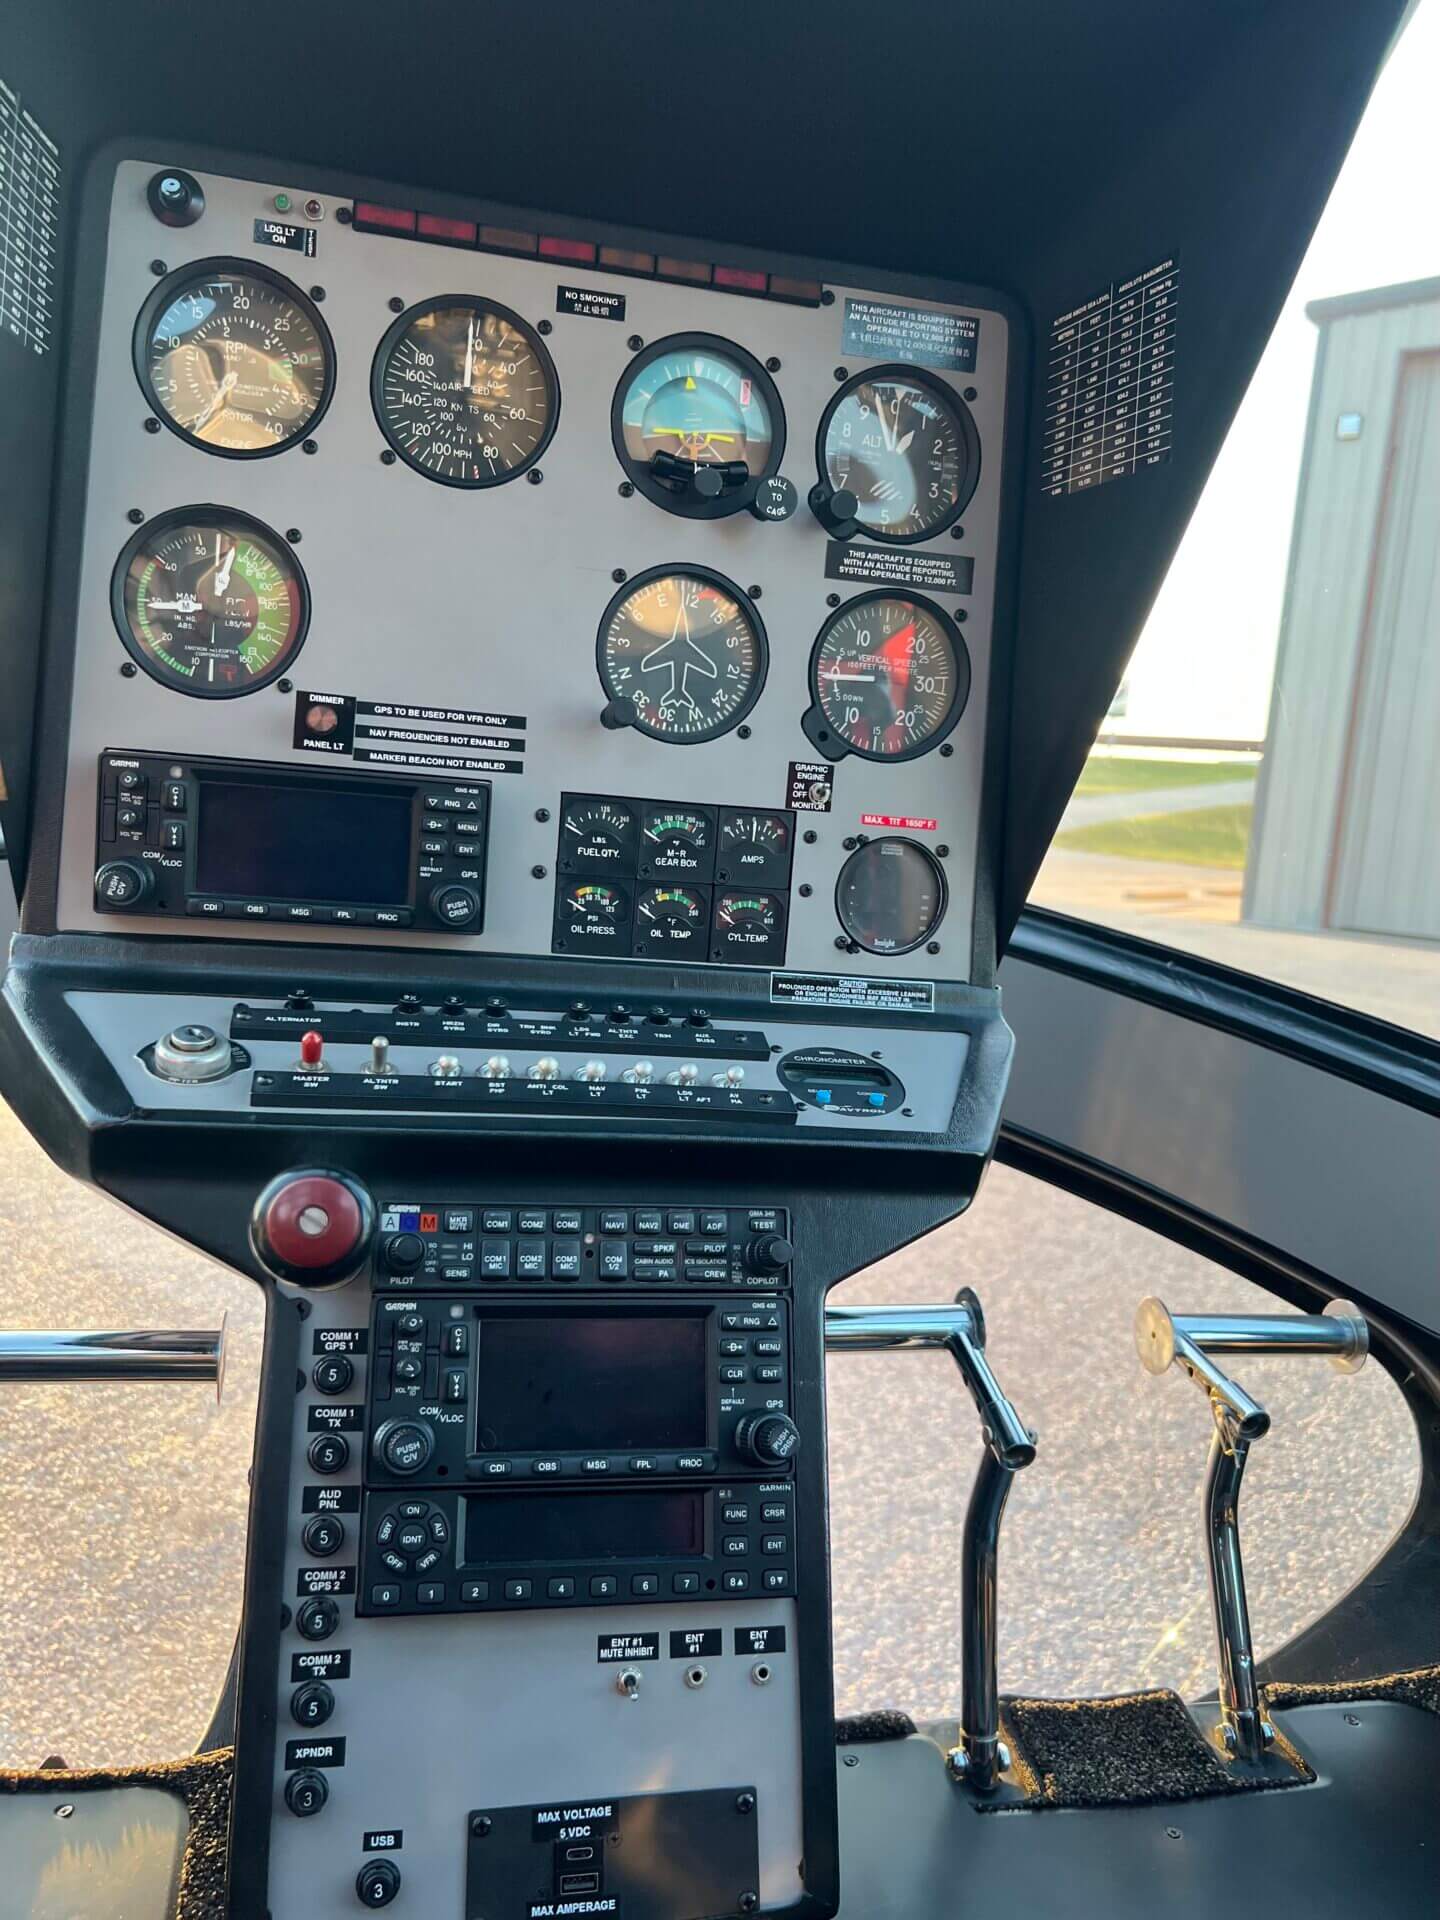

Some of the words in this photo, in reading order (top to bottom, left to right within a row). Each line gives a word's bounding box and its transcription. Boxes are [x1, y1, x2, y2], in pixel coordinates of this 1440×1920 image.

[264, 224, 284, 233] LDG
[285, 227, 296, 237] LT
[272, 235, 286, 244] ON
[233, 297, 249, 309] 20
[565, 291, 578, 300] NO
[579, 293, 618, 306] SMOKING
[192, 307, 203, 319] 15
[851, 303, 868, 312] THIS
[869, 307, 906, 319] AIRCRAFT
[917, 314, 955, 326] EQUIPPED
[274, 318, 290, 330] 25
[168, 337, 180, 348] 10
[415, 354, 434, 366] 180
[406, 369, 424, 382] 160
[402, 394, 422, 406] 140
[510, 408, 525, 420] 60
[859, 405, 870, 420] 9
[412, 424, 431, 436] 120
[842, 424, 851, 436] 8
[862, 435, 883, 447] ALT
[432, 445, 451, 455] 100
[483, 446, 498, 458] 80
[933, 440, 943, 454] 2
[453, 450, 472, 459] MPH
[768, 479, 788, 490] PULL
[929, 483, 939, 498] 3
[772, 493, 782, 501] TO
[766, 506, 786, 516] CAGE
[849, 550, 865, 559] THIS
[866, 552, 904, 563] AIRCRAFT
[914, 558, 951, 569] EQUIPPED
[165, 563, 177, 571] 40
[843, 558, 863, 566] WITH
[864, 560, 874, 568] AN
[875, 561, 910, 572] ALTITUDE
[912, 566, 955, 577] REPORTING
[839, 566, 869, 576] SYSTEM
[870, 570, 910, 581] OPERABLE
[686, 593, 698, 608] 12
[710, 609, 725, 624] 15
[162, 633, 173, 641] 20
[726, 636, 738, 648] S
[857, 630, 870, 646] 10
[906, 638, 925, 654] 20
[858, 654, 890, 664] VERTICAL
[893, 658, 916, 668] SPEED
[618, 667, 632, 679] N
[914, 676, 934, 692] 30
[310, 694, 344, 704] DIMMER
[375, 706, 392, 715] GPS
[395, 707, 406, 716] TO
[409, 709, 420, 717] BE
[422, 710, 445, 720] USED
[447, 713, 464, 721] FOR
[466, 714, 484, 723] VFR
[485, 716, 507, 726] ONLY
[845, 706, 859, 723] 10
[895, 710, 915, 727] 20
[304, 739, 332, 749] PANEL
[370, 729, 386, 737] NAV
[389, 730, 449, 743] FREQUENCIES
[451, 735, 468, 745] NOT
[470, 737, 510, 749] ENABLED
[370, 753, 406, 762] MARKER
[409, 756, 445, 766] BEACON
[447, 759, 464, 767] NOT
[466, 760, 505, 770] ENABLED
[795, 764, 828, 773] GRAPHIC
[797, 773, 825, 781] ENGINE
[445, 800, 460, 808] RNG
[791, 802, 825, 810] MONITOR
[864, 815, 884, 824] MAX.
[889, 817, 901, 825] TIT
[577, 847, 600, 856] FUEL
[601, 849, 620, 858] QTY.
[741, 855, 764, 864] AMPS
[571, 925, 584, 933] OIL
[586, 926, 616, 935] PRESS.
[839, 980, 867, 988] CAUTION
[794, 1056, 866, 1065] CHRONOMETER
[705, 1270, 726, 1278] CREW
[747, 1277, 778, 1285] COPILOT
[743, 1317, 760, 1325] RNG
[325, 1342, 346, 1350] GPS
[349, 1342, 353, 1350] 1
[759, 1343, 780, 1351] MENU
[328, 1369, 337, 1382] 5
[315, 1409, 347, 1417] COMM
[350, 1409, 354, 1417] 1
[328, 1419, 341, 1427] TX
[490, 1464, 505, 1472] CDI
[680, 1459, 702, 1468] PROC
[319, 1490, 342, 1498] AUD
[319, 1500, 339, 1508] PNL
[726, 1510, 747, 1518] FUNC
[402, 1535, 422, 1544] IDNT
[305, 1571, 338, 1580] COMM
[340, 1571, 346, 1579] 2
[309, 1582, 332, 1591] GPS
[334, 1581, 340, 1590] 2
[685, 1634, 704, 1643] ENT
[750, 1631, 768, 1640] ENT
[611, 1638, 631, 1647] ENT
[632, 1638, 642, 1646] #1
[689, 1644, 700, 1652] #1
[754, 1641, 764, 1649] #2
[601, 1649, 623, 1657] MUTE
[625, 1647, 653, 1656] INHIBIT
[299, 1656, 332, 1666] COMM
[335, 1655, 341, 1664] 2
[313, 1666, 327, 1676] TX
[295, 1747, 333, 1759] XPNDR
[538, 1811, 560, 1824] MAX
[564, 1805, 611, 1821] VOLTAGE
[371, 1835, 394, 1846] USB
[531, 1905, 554, 1917] MAX
[556, 1900, 616, 1915] AMPERAGE
